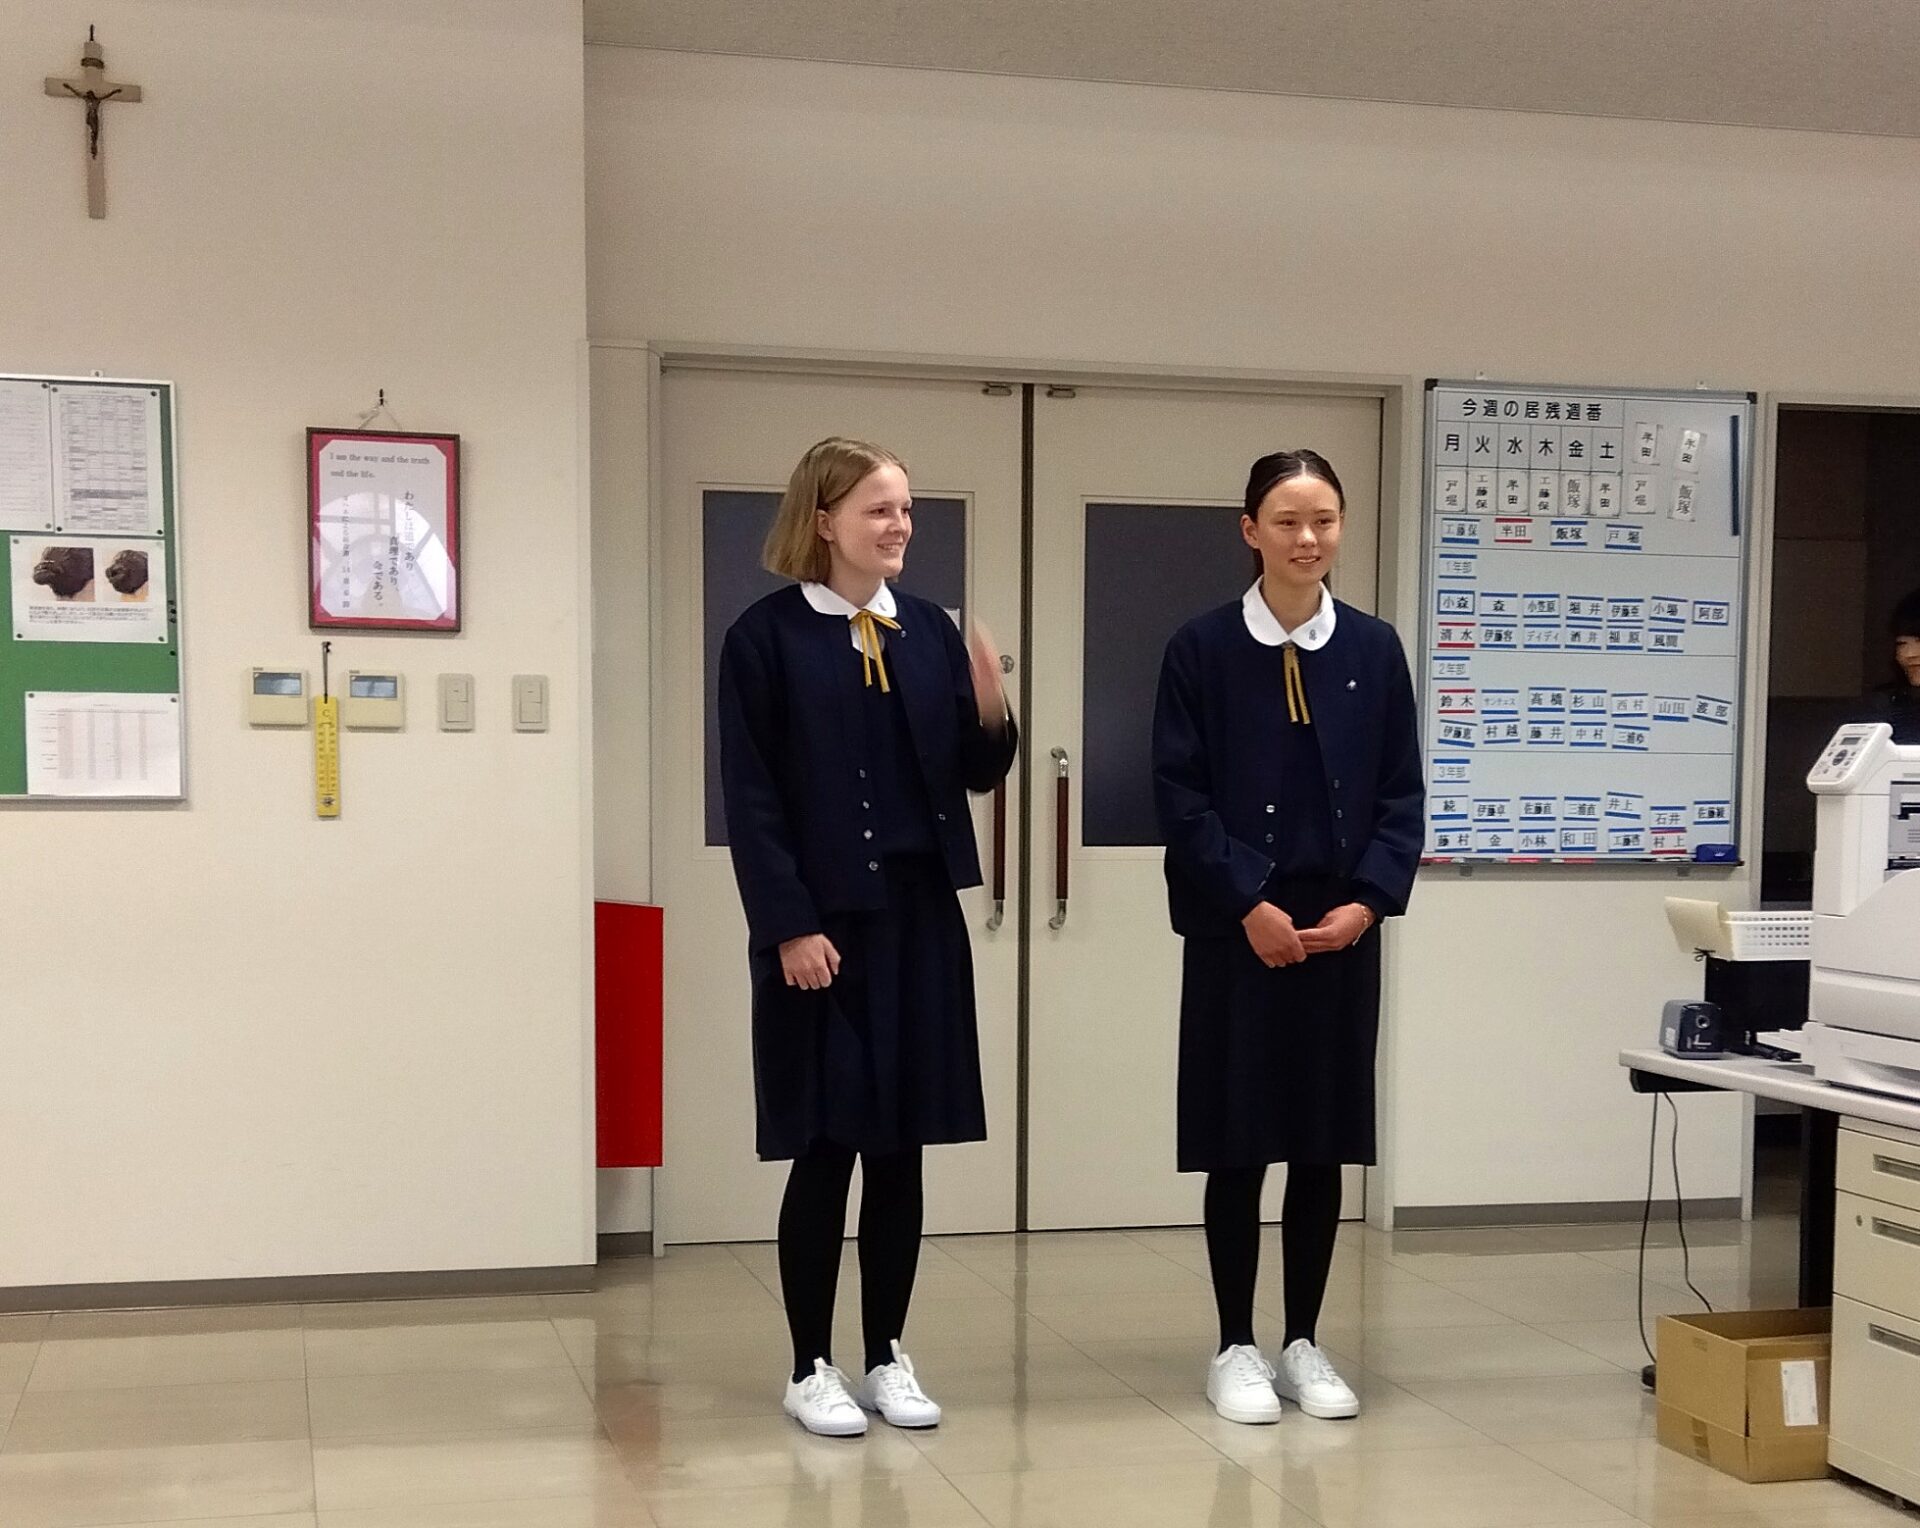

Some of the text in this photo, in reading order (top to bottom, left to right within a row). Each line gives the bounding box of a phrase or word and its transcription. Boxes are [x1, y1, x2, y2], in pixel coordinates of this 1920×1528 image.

[1462, 398, 1602, 421] 今週の居残週番
[1444, 434, 1614, 459] 月 火 水 木 金 土
[349, 453, 361, 461] the
[364, 455, 378, 463] way
[381, 455, 395, 463] and
[397, 455, 409, 464] the
[411, 456, 430, 464] truth
[346, 470, 358, 478] the
[1493, 600, 1505, 612] 森
[1439, 663, 1466, 675] 2年部
[1440, 695, 1473, 707] 鈴木
[1573, 695, 1604, 708] 杉山
[1616, 699, 1644, 711] 西村
[1659, 701, 1685, 714] 山田
[1576, 729, 1603, 740] 中村
[1608, 797, 1633, 811] 井上
[1656, 812, 1681, 825] 石井
[1489, 834, 1502, 846] 金
[1522, 835, 1546, 847] 小林
[1562, 832, 1596, 845] 和田
[1653, 835, 1685, 848] 村上
